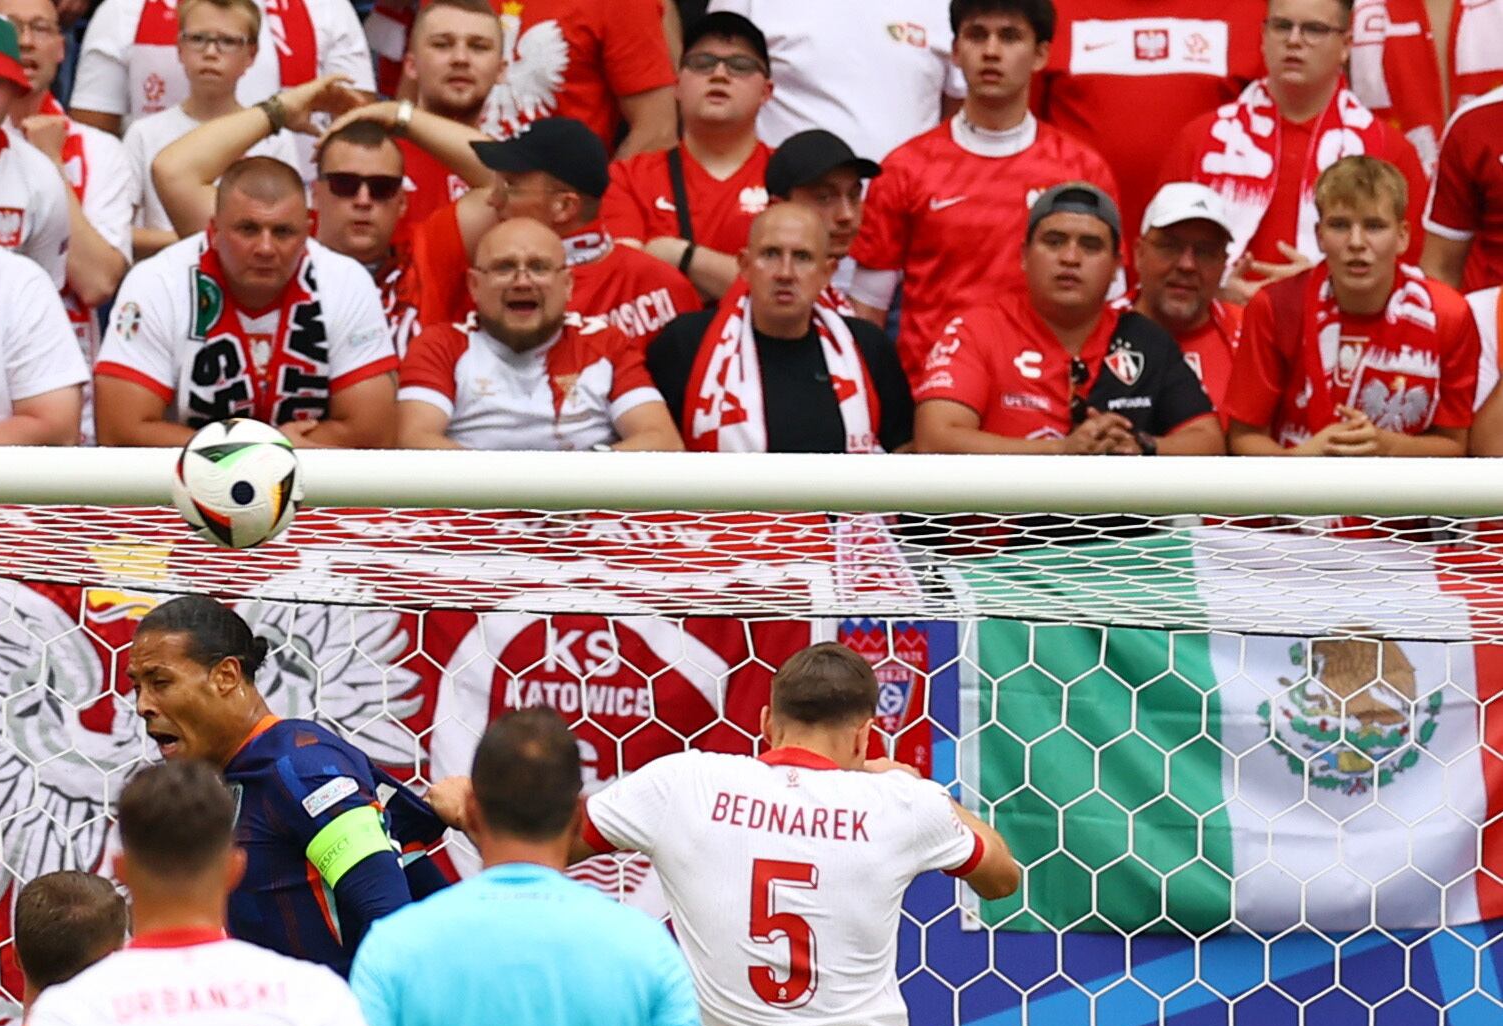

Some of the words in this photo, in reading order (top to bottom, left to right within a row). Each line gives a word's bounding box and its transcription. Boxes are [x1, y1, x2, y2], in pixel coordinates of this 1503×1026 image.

[544, 627, 621, 678] KS
[504, 679, 650, 719] KATOWICE
[711, 791, 870, 843] BEDNAREK
[747, 857, 820, 1010] 5
